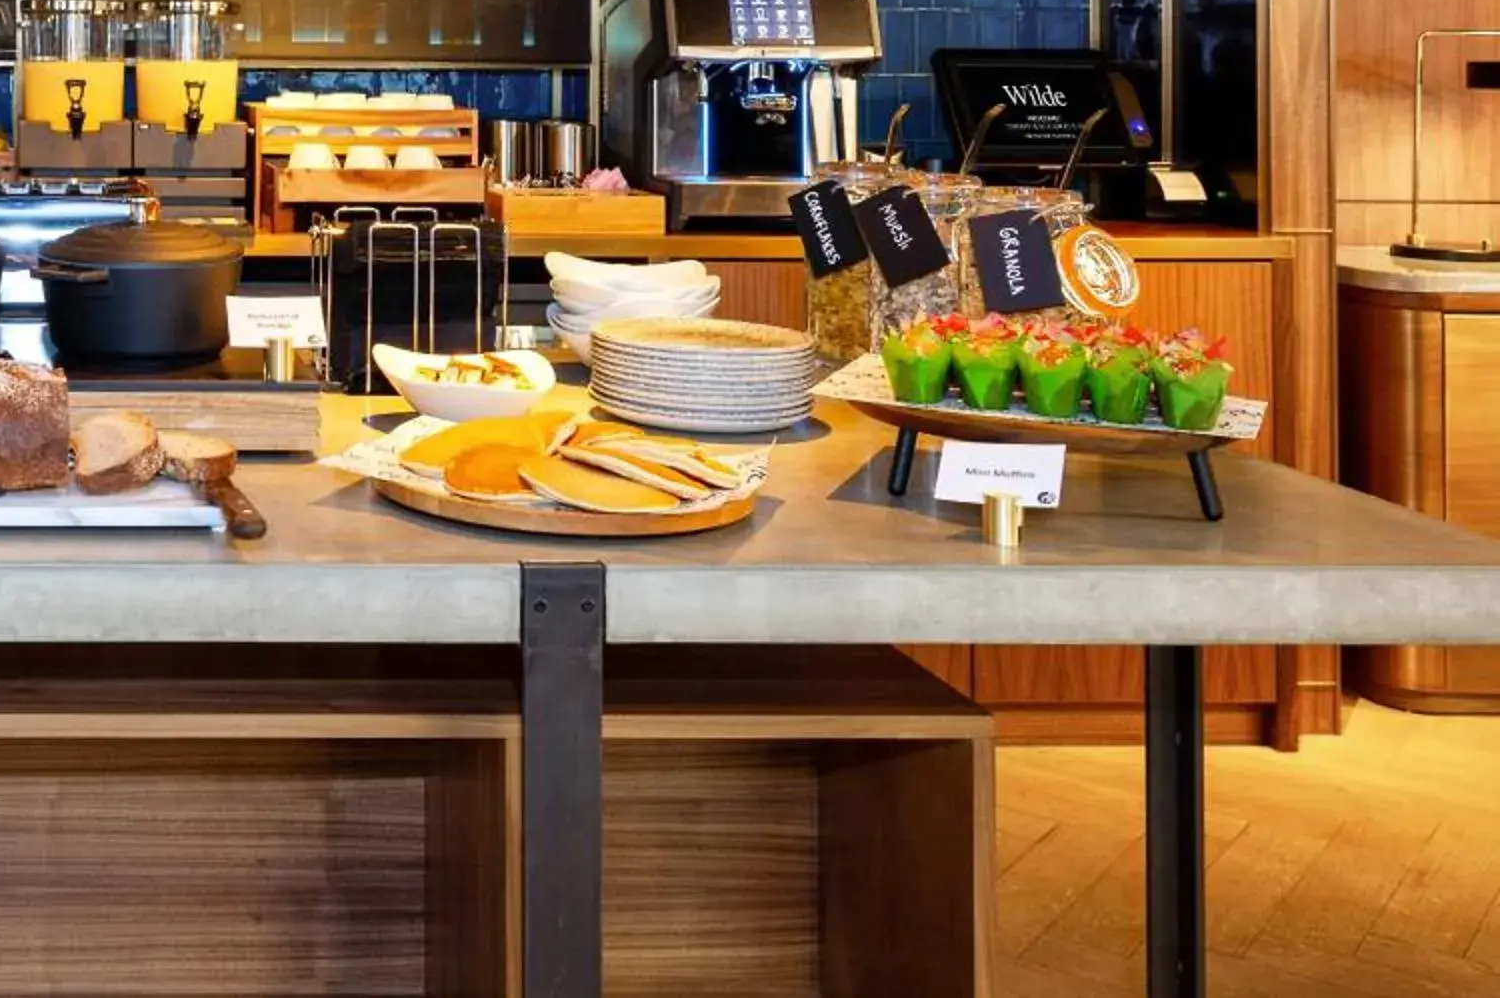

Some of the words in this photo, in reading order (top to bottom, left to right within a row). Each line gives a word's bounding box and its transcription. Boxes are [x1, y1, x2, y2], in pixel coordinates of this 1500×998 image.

[1001, 83, 1068, 107] Wilde
[803, 191, 841, 265] CORNFLAKES
[999, 227, 1026, 296] GRANOLA
